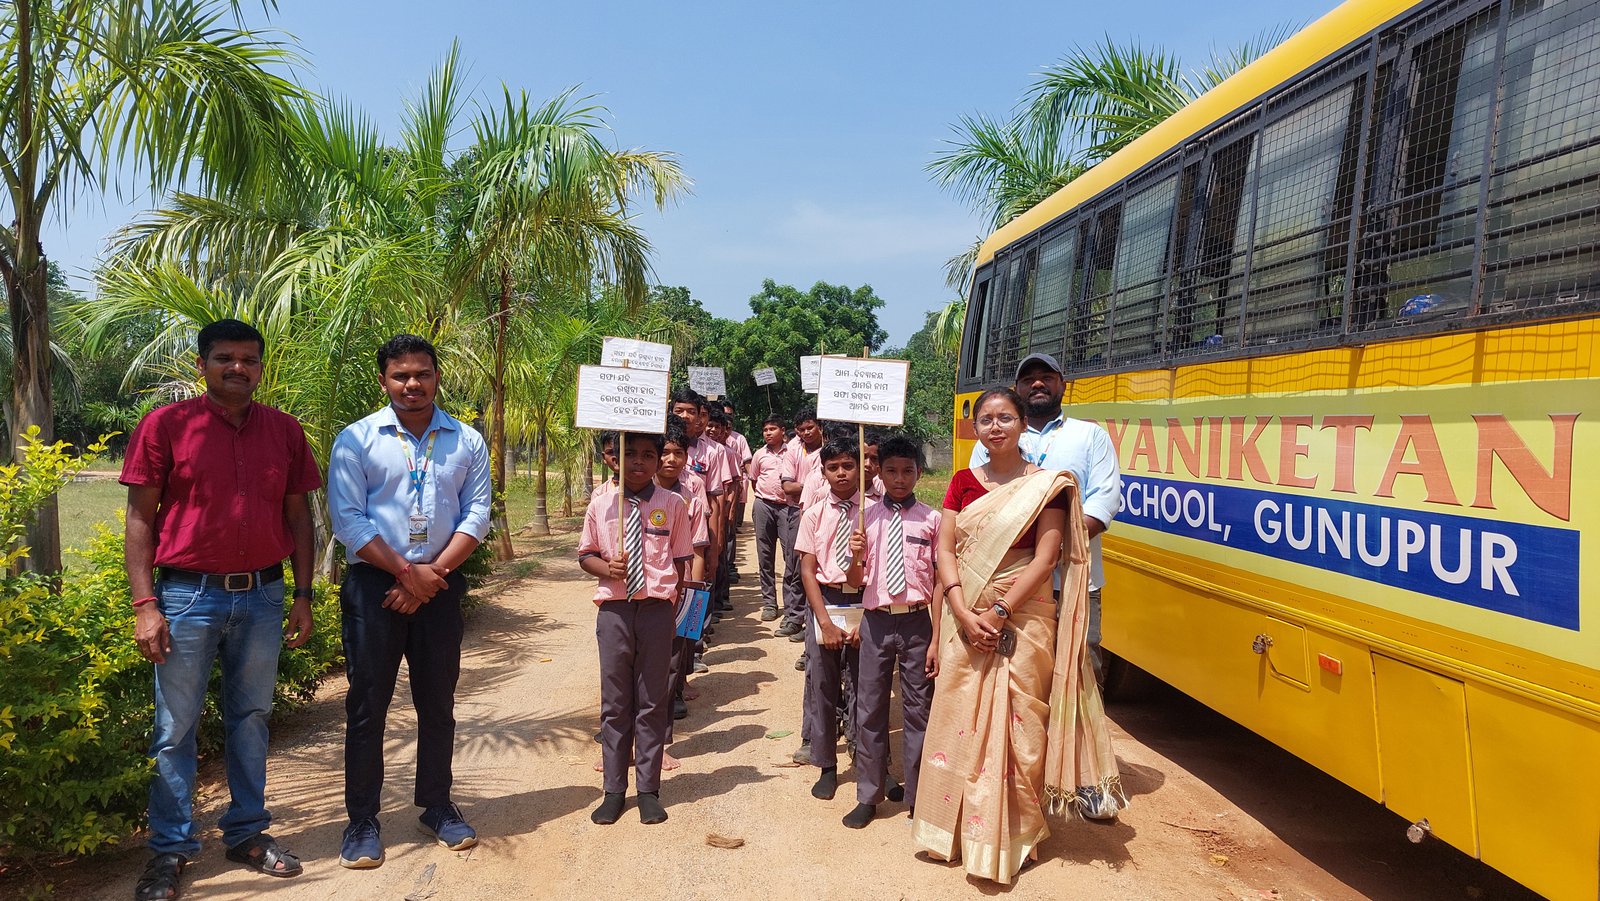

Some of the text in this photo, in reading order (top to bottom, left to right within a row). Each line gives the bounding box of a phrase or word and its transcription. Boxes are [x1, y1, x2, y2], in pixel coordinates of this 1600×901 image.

[600, 373, 630, 381] ସଫା ଯଦି
[835, 369, 850, 377] ଆମ
[851, 381, 872, 389] ଆମରି
[833, 390, 849, 398] ସଫା
[600, 395, 620, 403] ରୋଗ
[849, 402, 869, 410] ଆମରି
[1078, 413, 1583, 521] YANIKETAN
[1253, 498, 1521, 597] GUNUPUR
